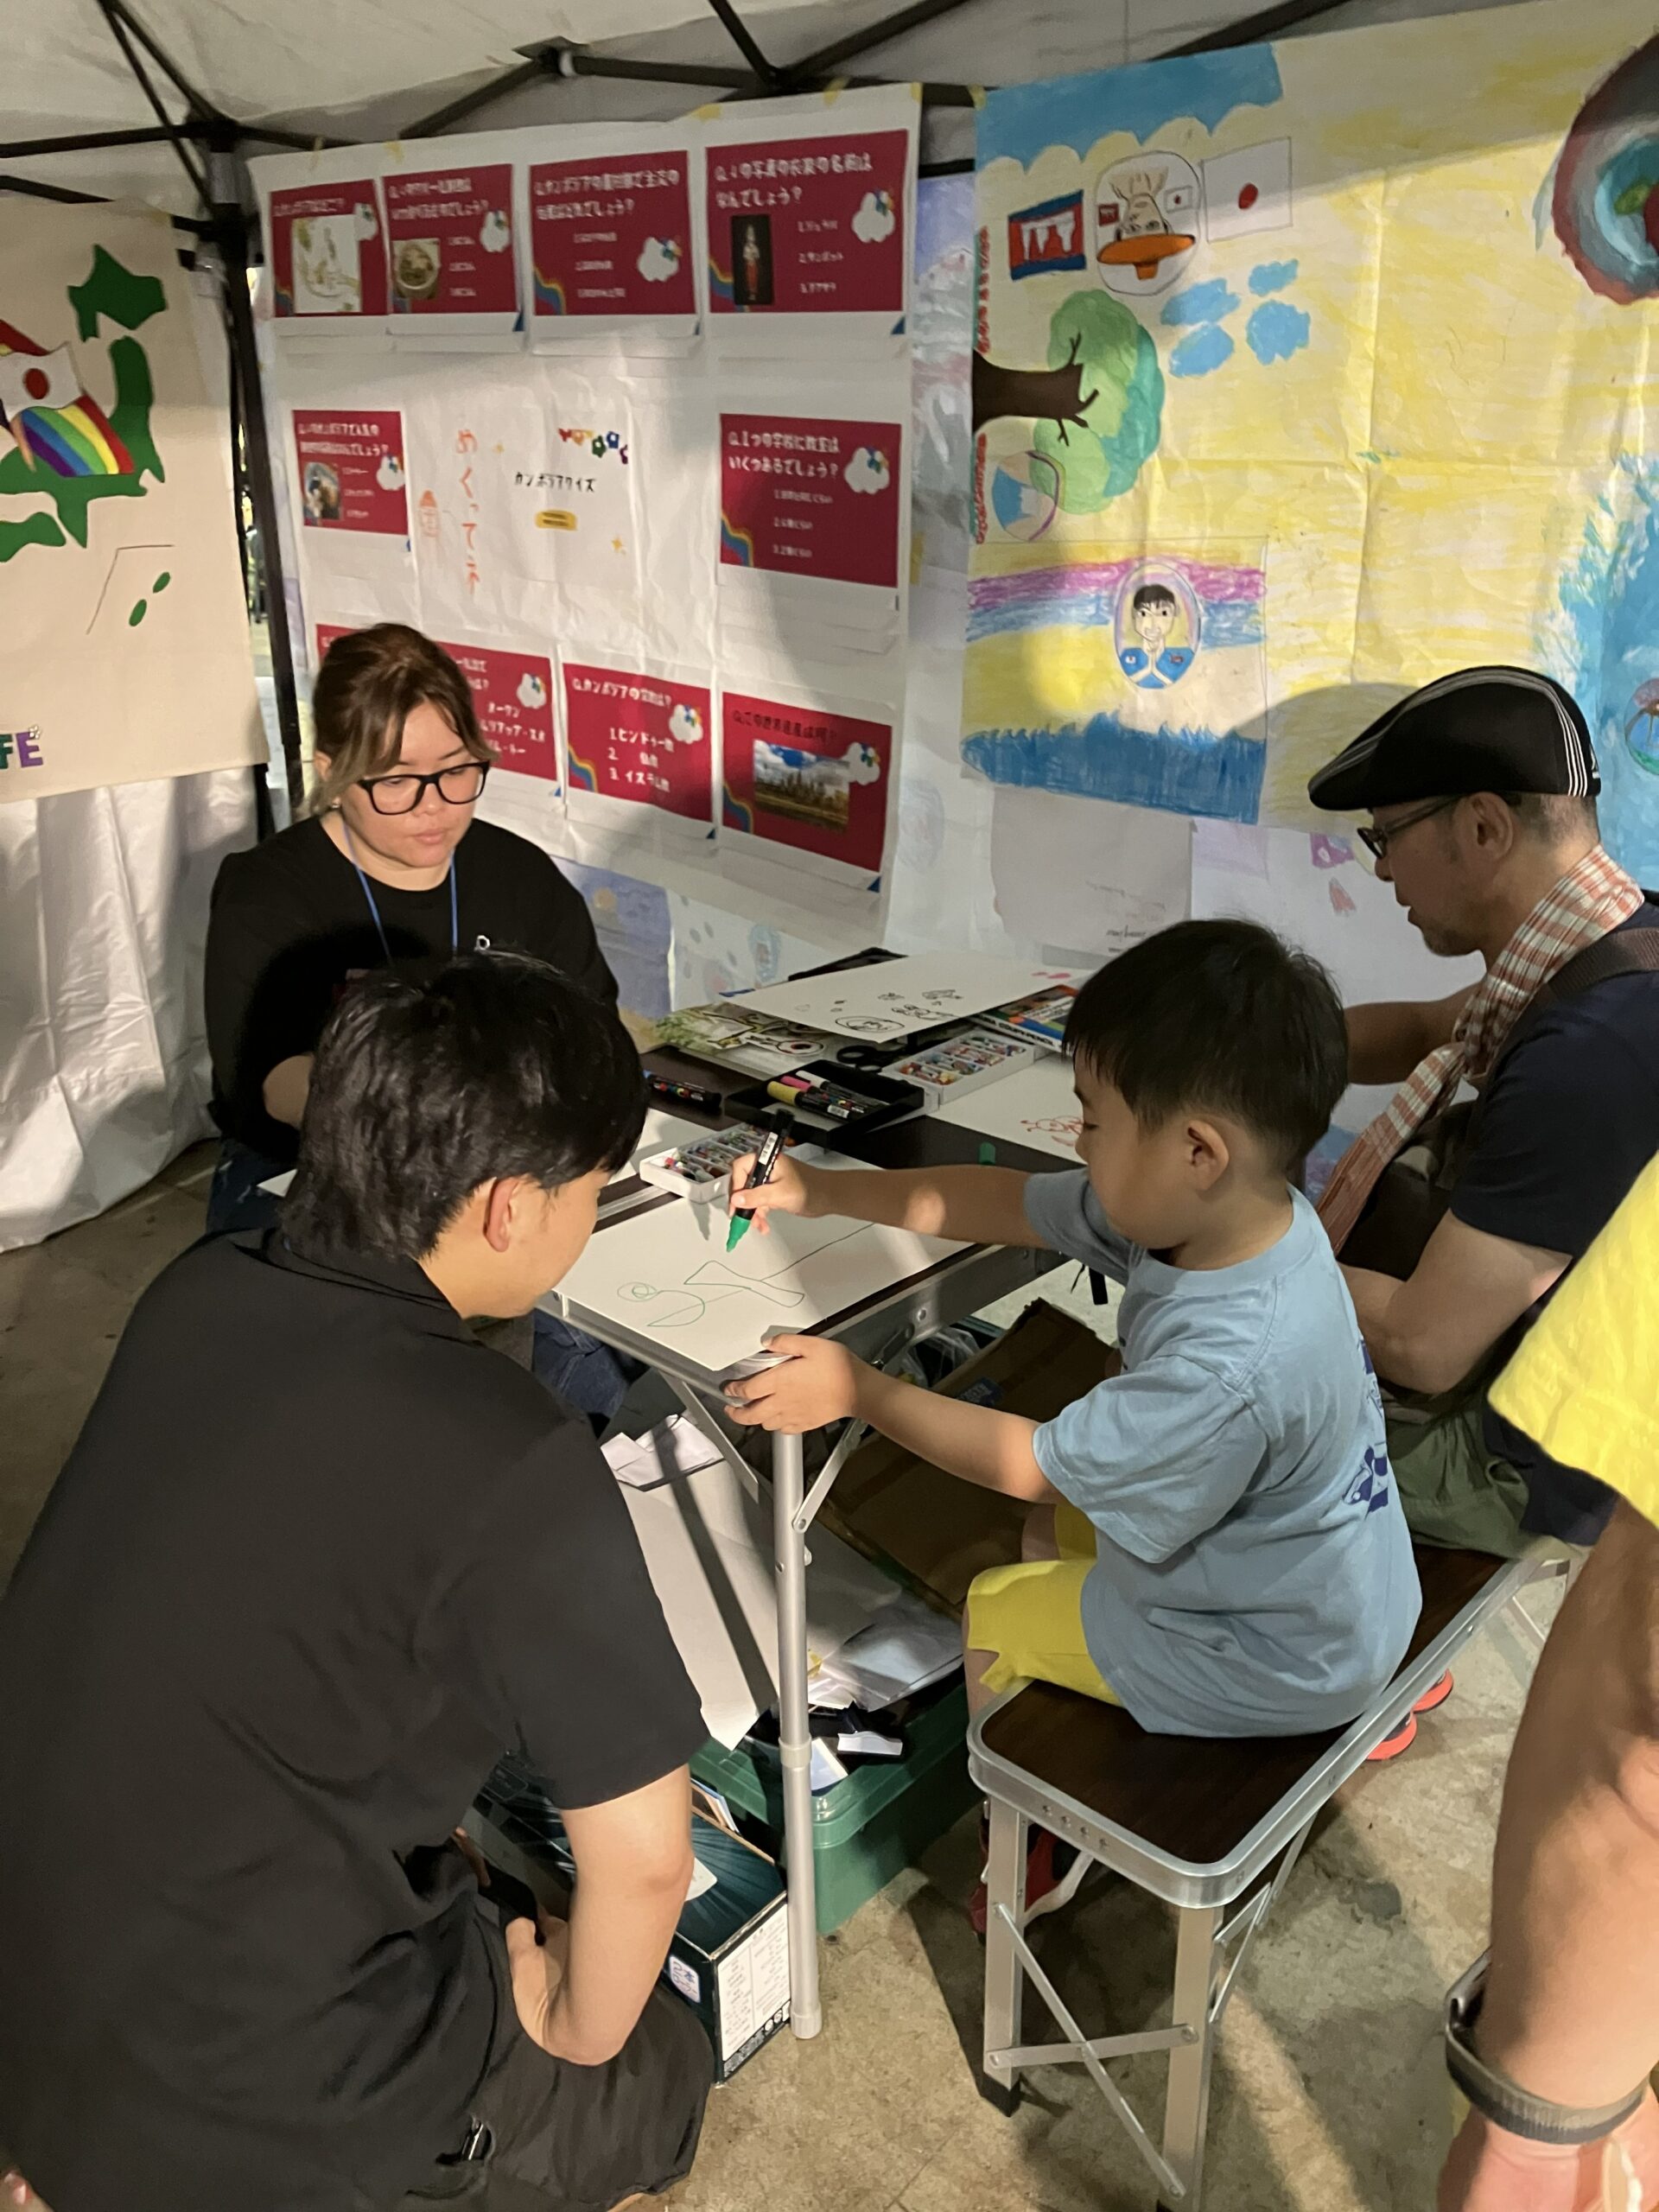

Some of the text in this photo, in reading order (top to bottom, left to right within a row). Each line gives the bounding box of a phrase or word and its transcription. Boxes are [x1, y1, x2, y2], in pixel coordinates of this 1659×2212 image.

[728, 456, 838, 478] いくつあるでしょう?
